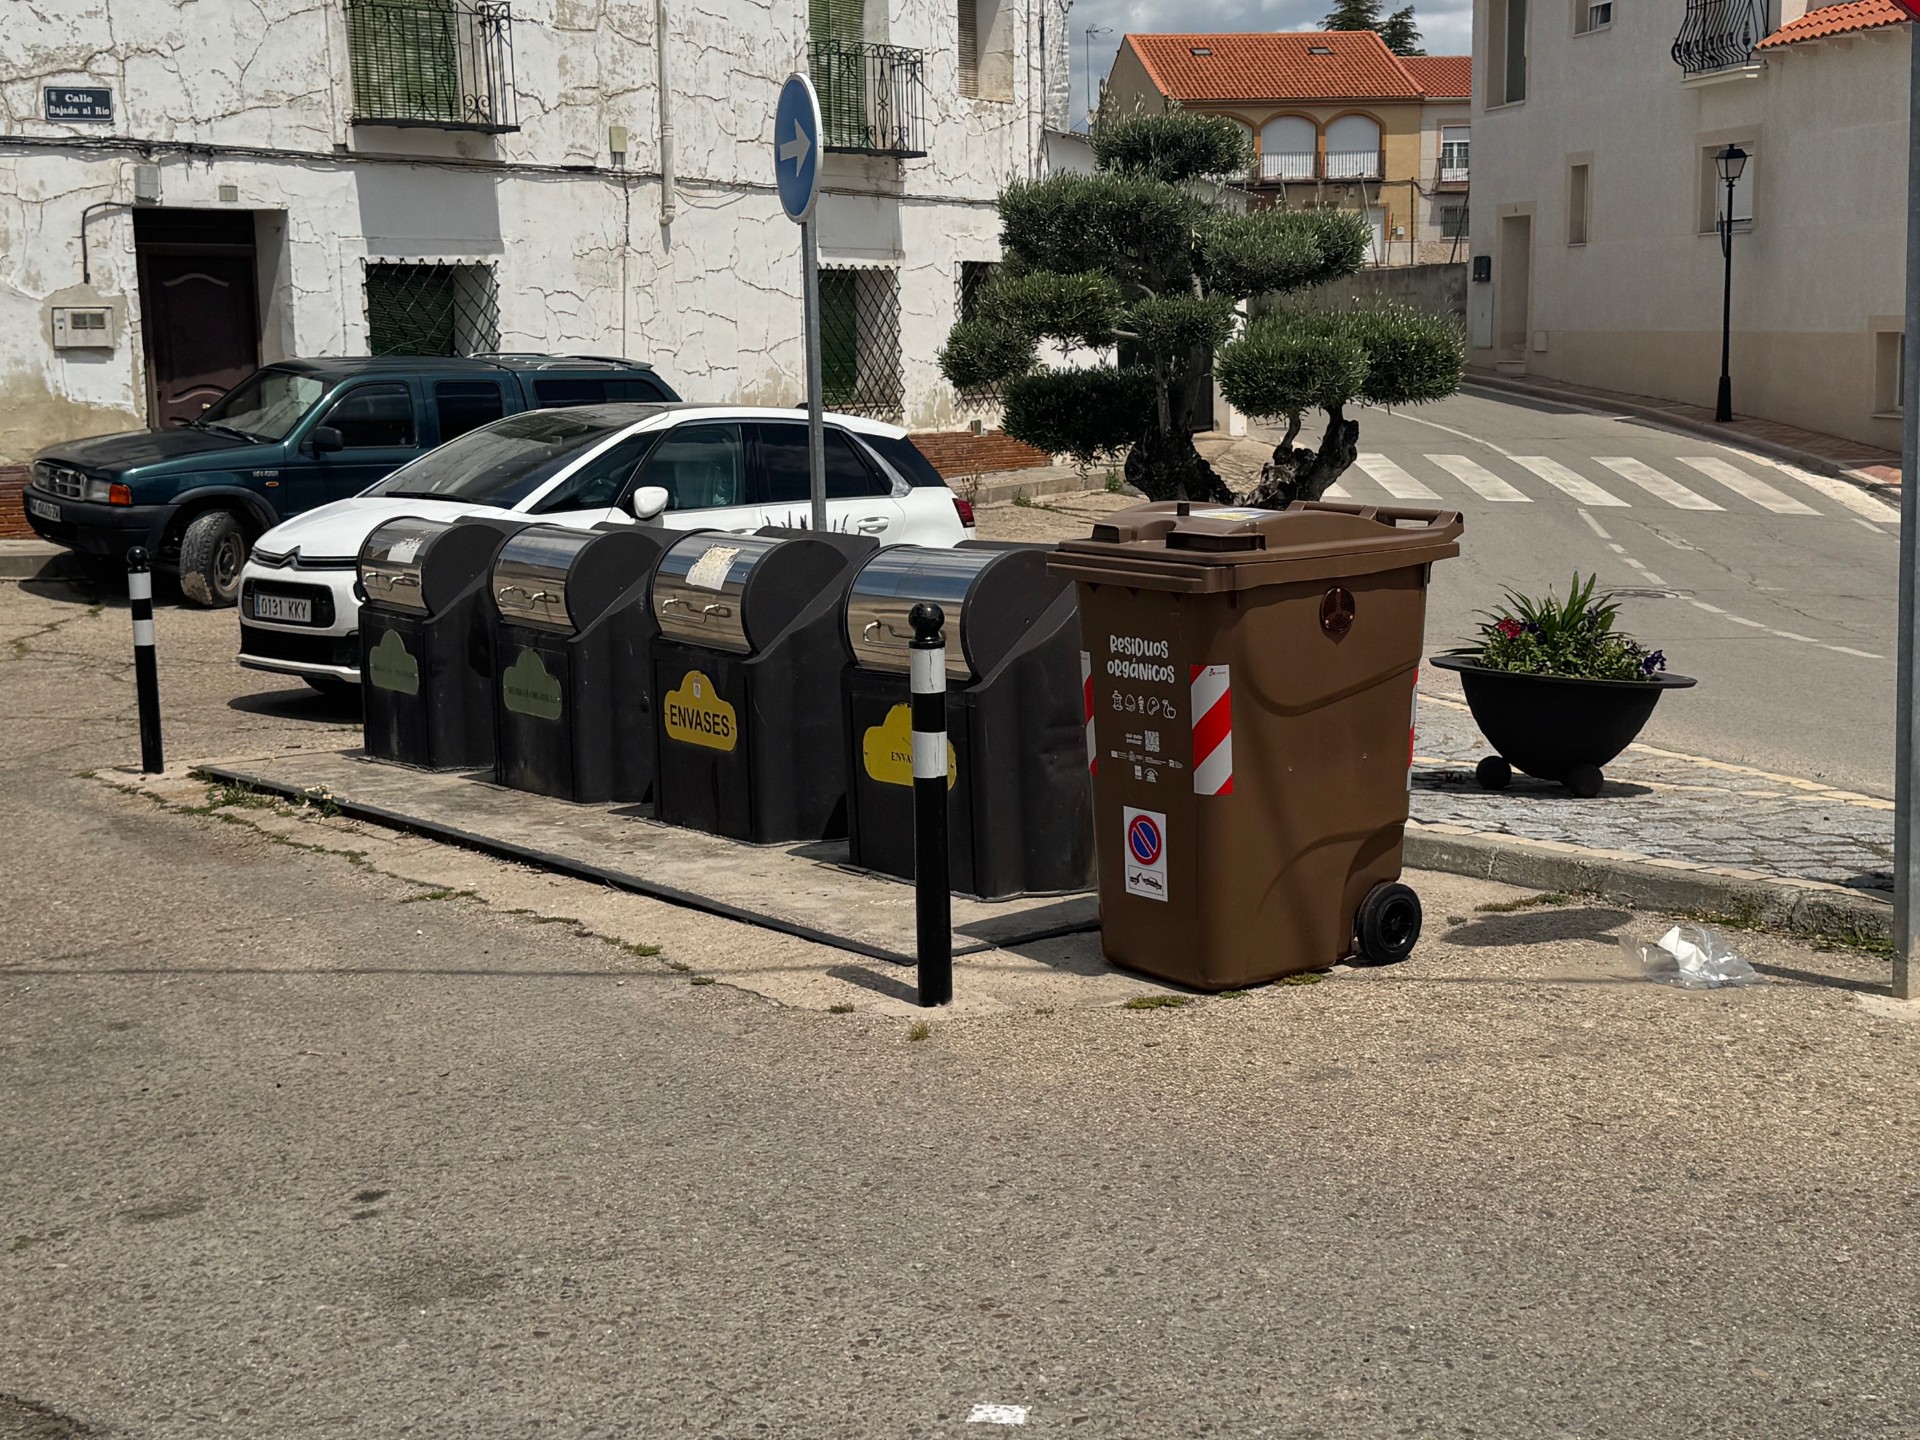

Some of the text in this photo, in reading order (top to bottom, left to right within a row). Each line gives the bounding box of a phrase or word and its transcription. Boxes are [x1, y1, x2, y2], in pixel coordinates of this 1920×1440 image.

[65, 94, 93, 103] Calle
[49, 105, 79, 116] Bajada
[82, 106, 92, 115] al
[261, 598, 307, 619] 0131 KKY
[670, 704, 730, 737] ENVASES
